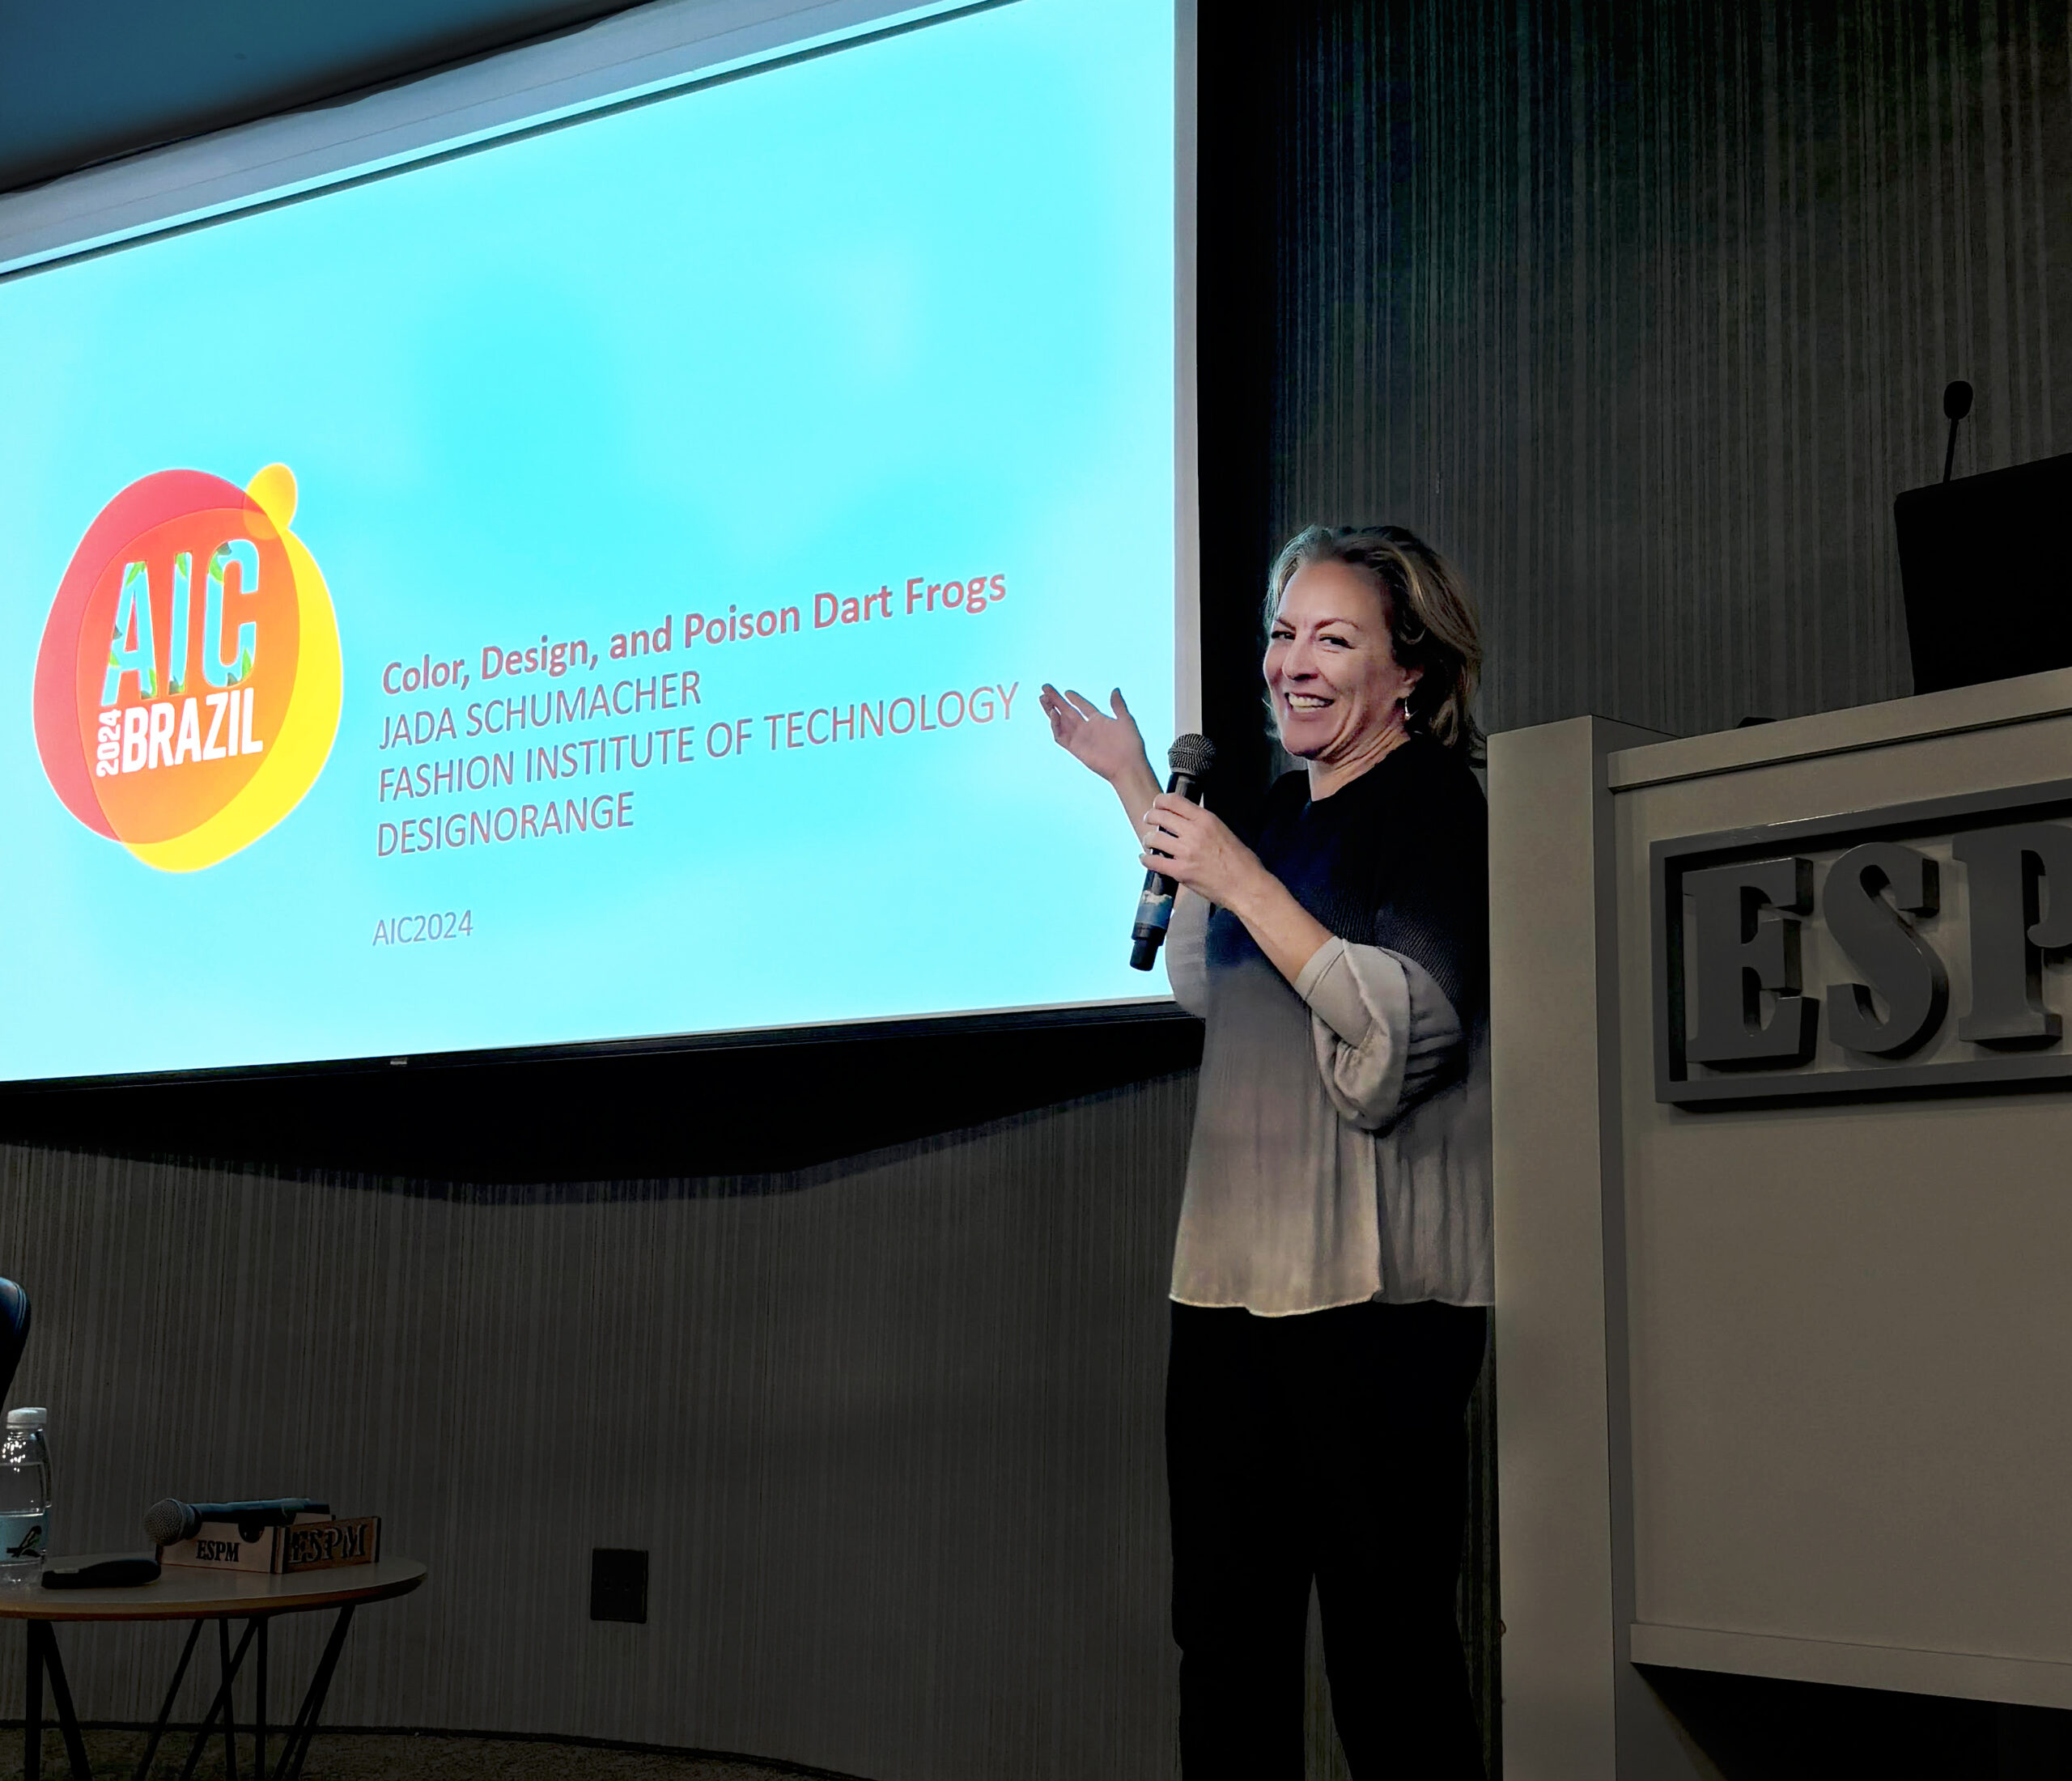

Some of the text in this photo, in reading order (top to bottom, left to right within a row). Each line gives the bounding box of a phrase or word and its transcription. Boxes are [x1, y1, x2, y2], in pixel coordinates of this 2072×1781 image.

[101, 539, 260, 706] AIC
[384, 575, 1005, 694] Color, Design, and Poison Dart Frogs
[96, 708, 121, 778] 2024
[121, 687, 263, 774] BRAZIL
[380, 671, 701, 749] JADA SCHUMACHER
[380, 682, 1018, 802] FASHION INSTITUTE OF TECHNOLOGY
[378, 791, 634, 856] DESIGNORANGE
[373, 910, 473, 946] AIC2024
[196, 1539, 240, 1562] ESPM
[288, 1524, 367, 1563] ESPM
